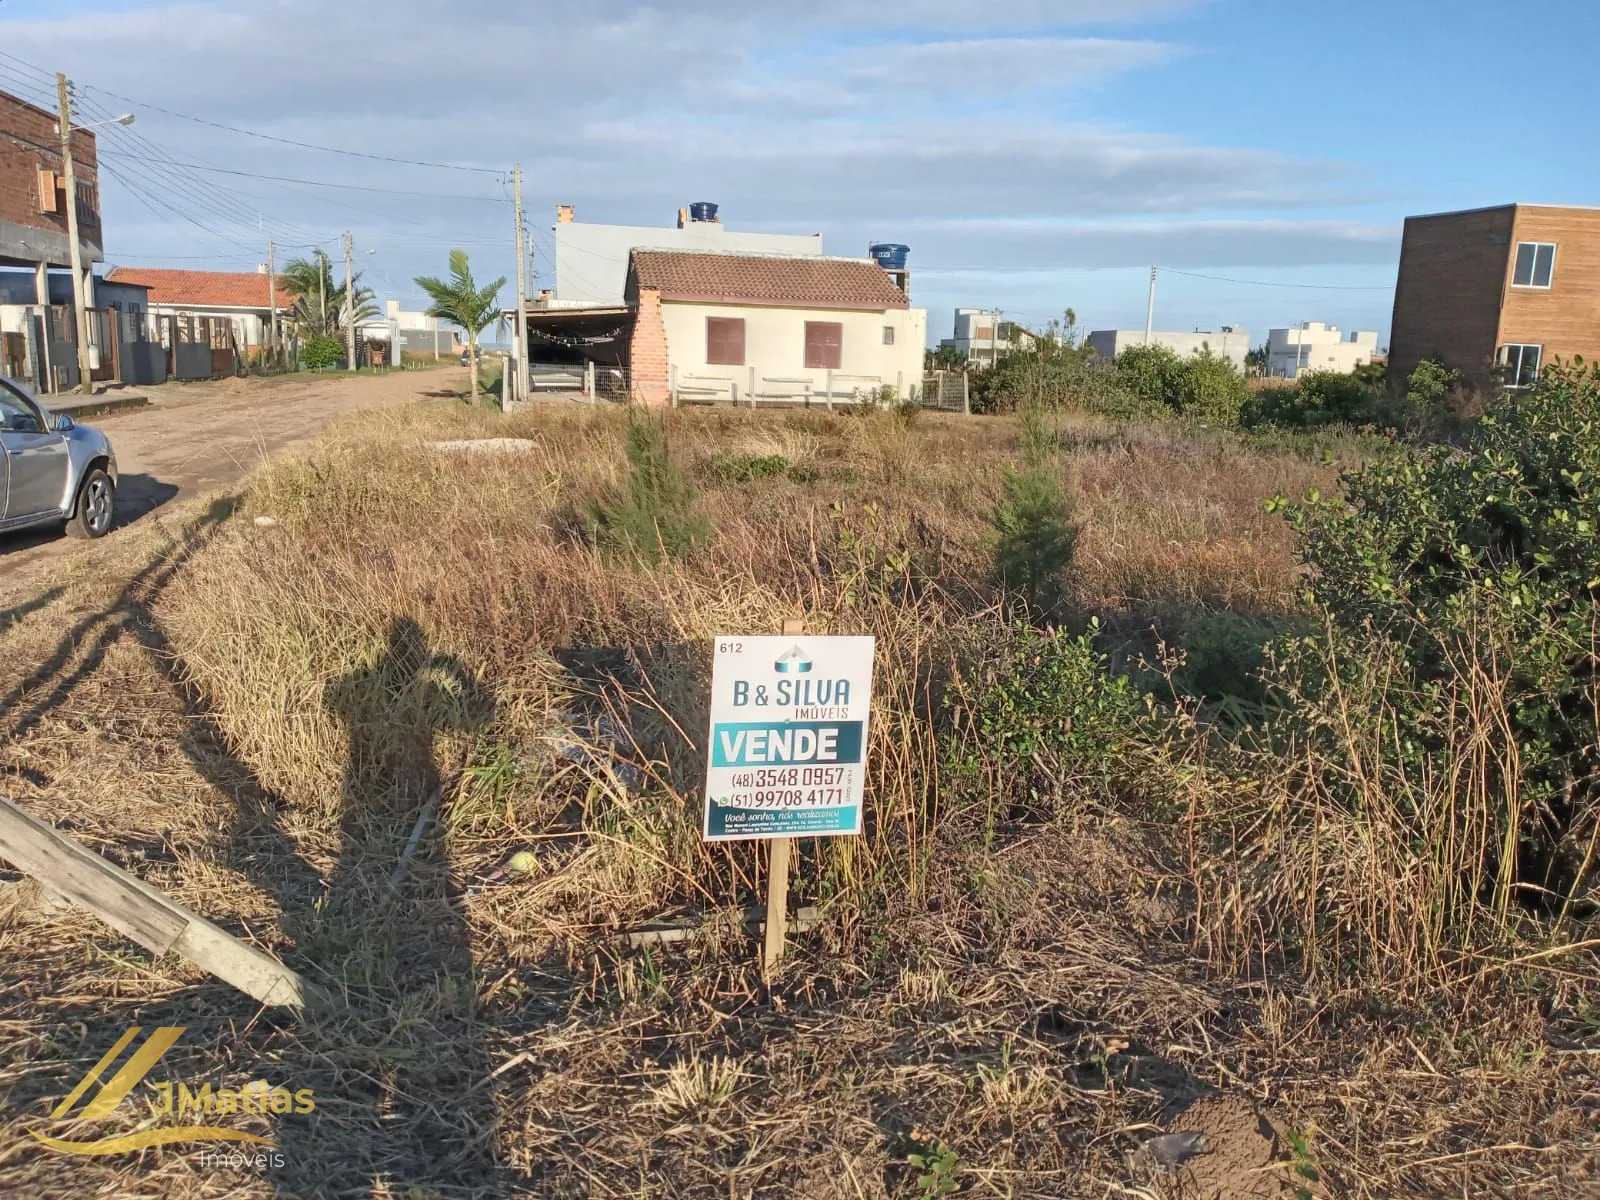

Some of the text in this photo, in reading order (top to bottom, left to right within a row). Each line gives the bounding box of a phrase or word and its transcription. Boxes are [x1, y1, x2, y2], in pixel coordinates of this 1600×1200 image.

[719, 642, 743, 654] 612
[733, 678, 850, 707] B & SILVA
[795, 705, 849, 720] IMÓVEIS
[719, 728, 839, 763] VENDE
[732, 772, 754, 788] (48)
[756, 768, 798, 788] 3548
[802, 767, 845, 786] 0957
[730, 788, 842, 808] (51) 99708 4171
[725, 811, 746, 823] Você
